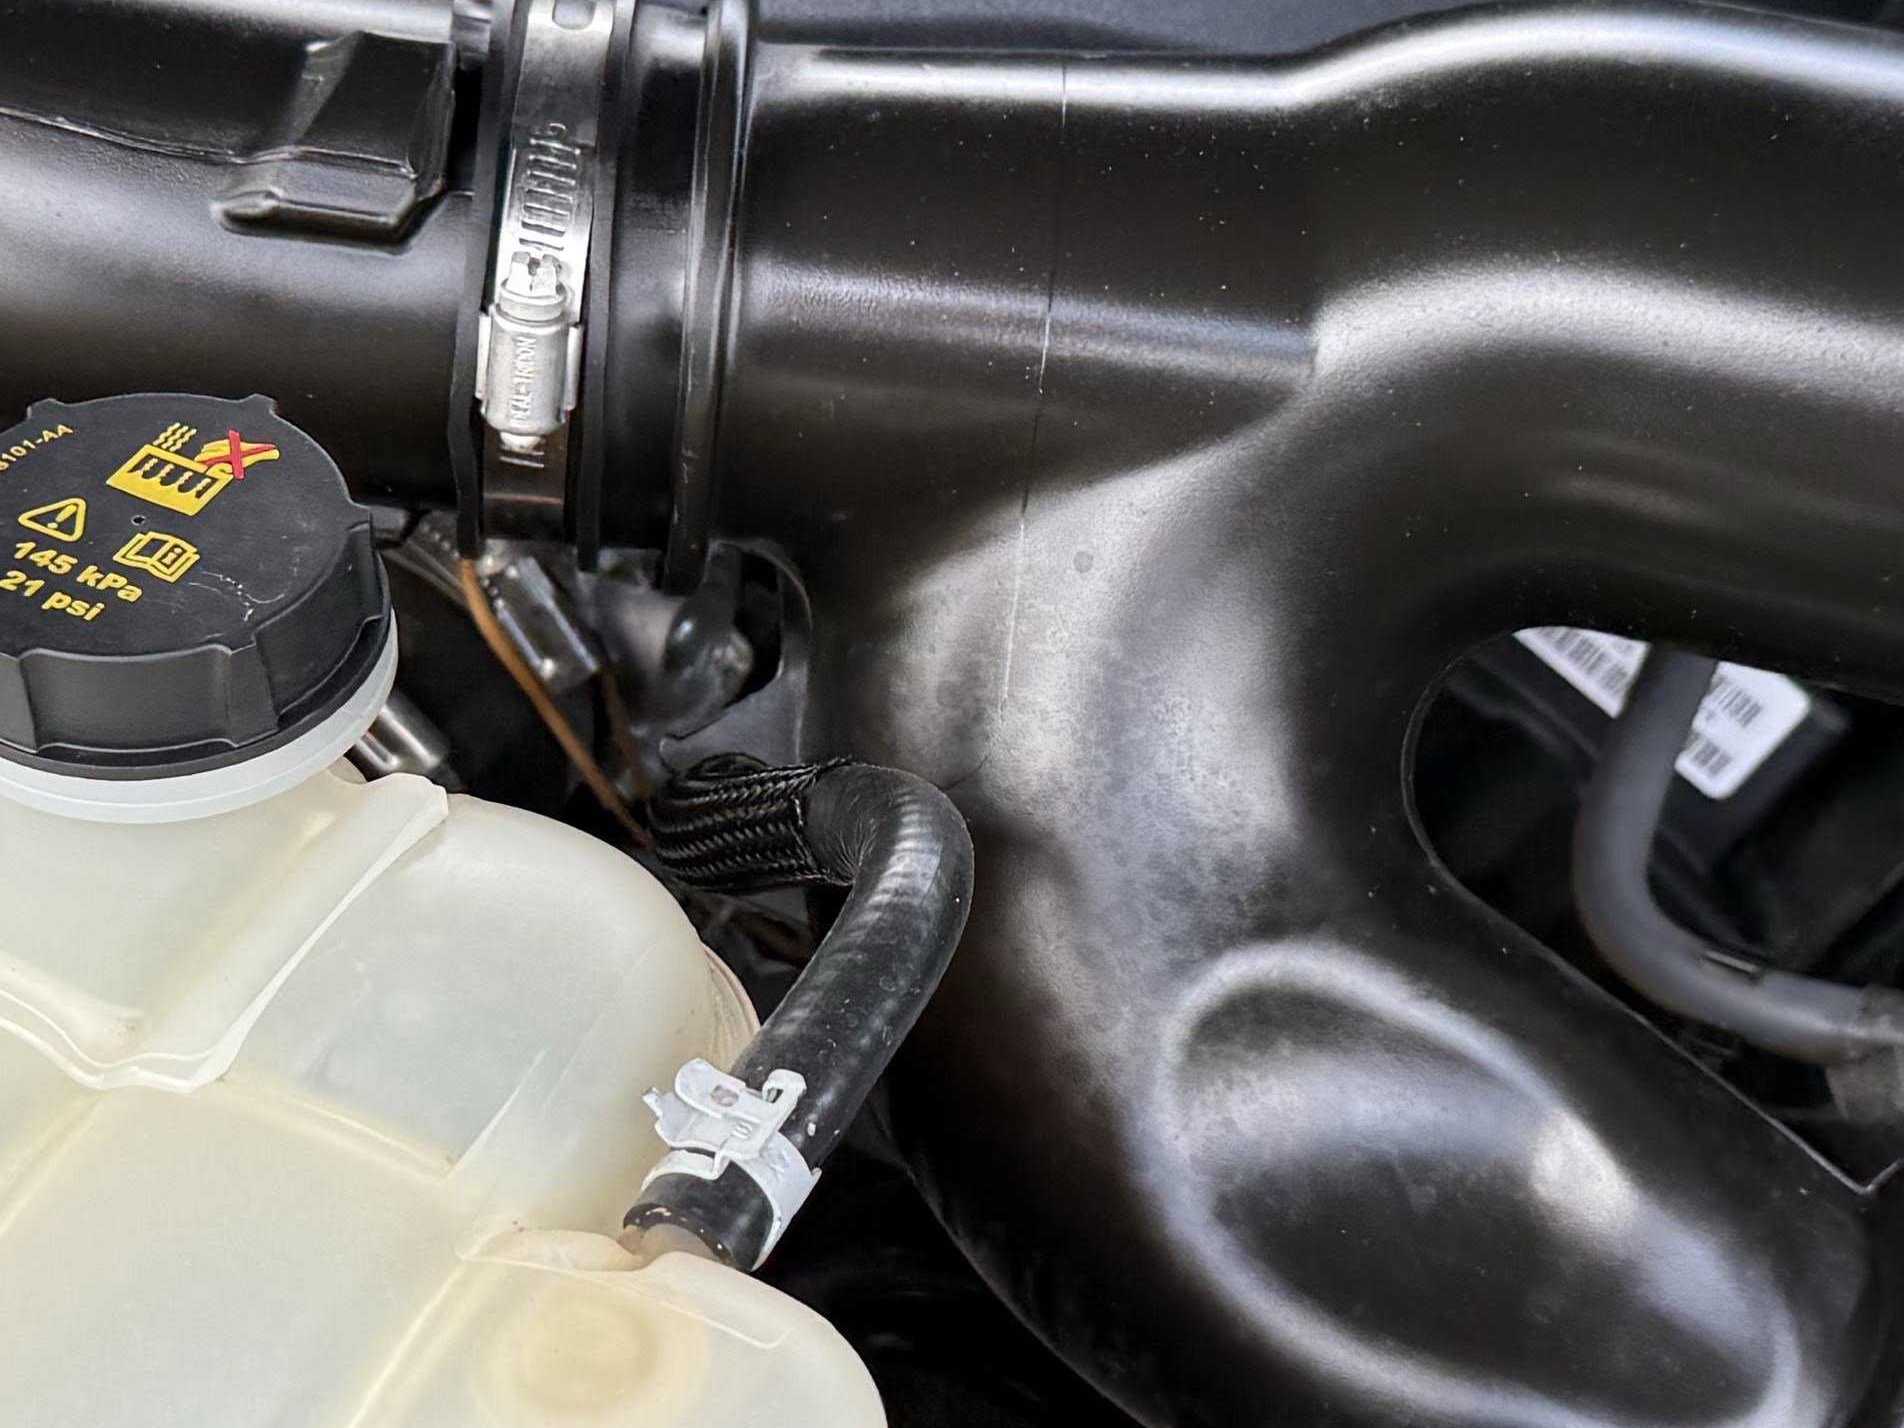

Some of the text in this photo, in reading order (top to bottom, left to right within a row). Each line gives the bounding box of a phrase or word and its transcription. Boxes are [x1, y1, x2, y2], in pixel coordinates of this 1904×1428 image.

[14, 541, 143, 603] 145 kPa
[42, 588, 106, 621] psi
